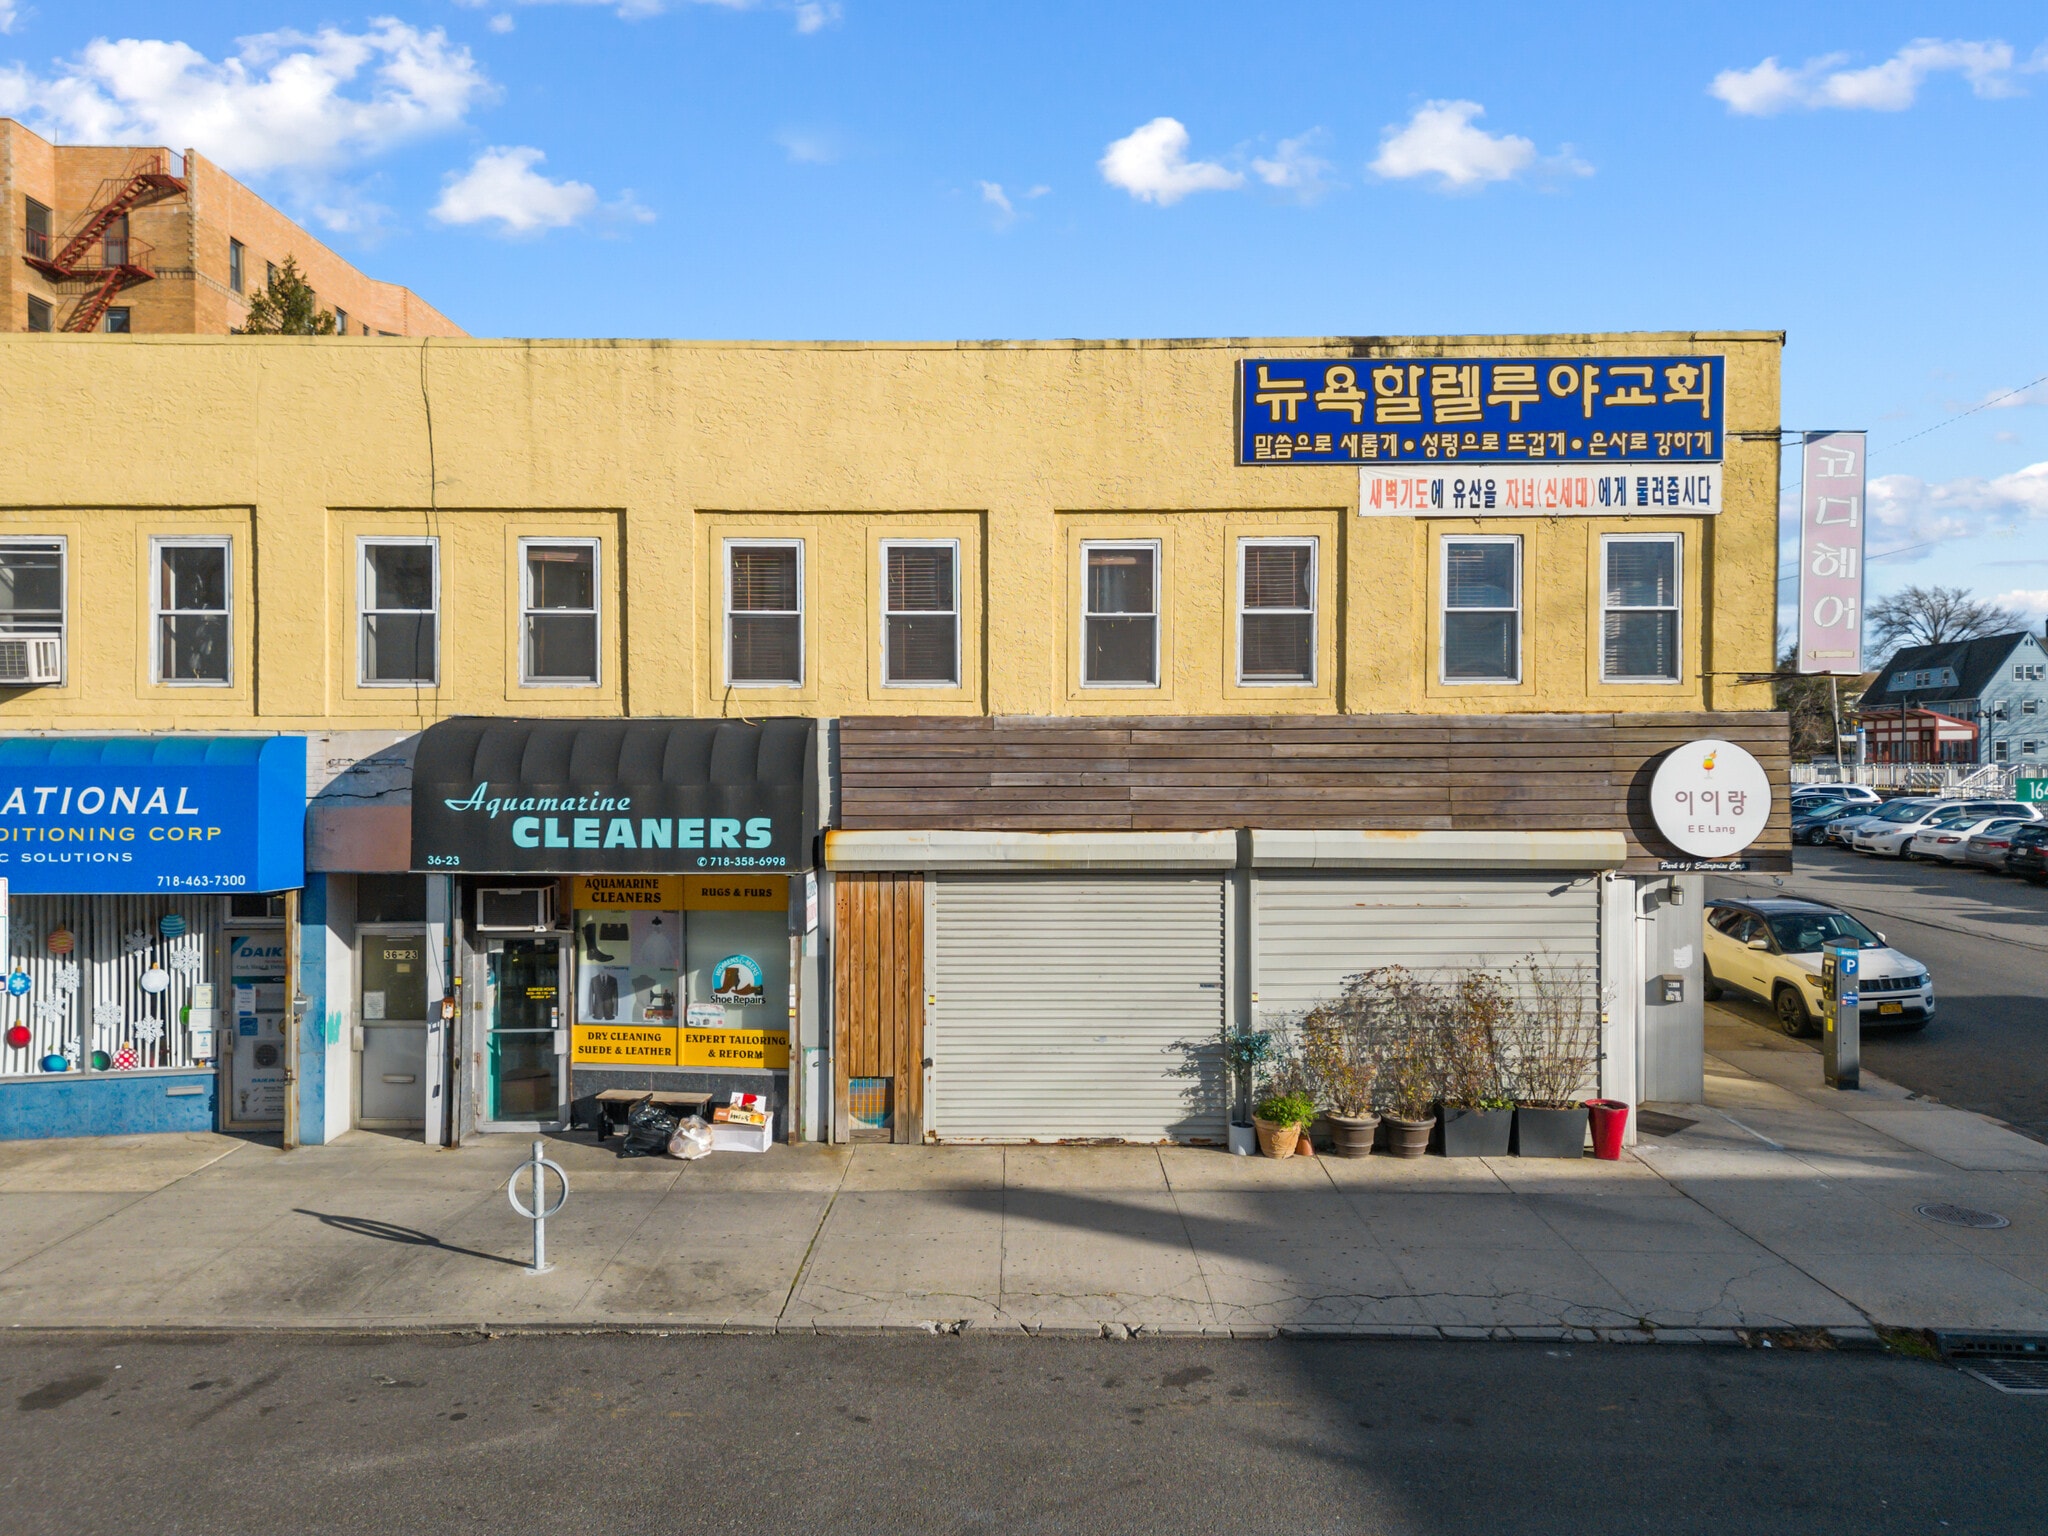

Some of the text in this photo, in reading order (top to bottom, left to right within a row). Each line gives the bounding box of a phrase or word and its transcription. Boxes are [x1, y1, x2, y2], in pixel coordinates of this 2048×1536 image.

[1255, 363, 1711, 424] 뉴욕할렐루야교회
[1255, 431, 1713, 460] 말씀으로 새롭게 성령으로 뜨겁게 은사로 강하게
[1369, 474, 1712, 510] 새벽기도에 유산을 자녀(신세대)에게 물려줍시다
[0, 786, 199, 815] ATIONAL
[444, 781, 631, 819] Aquamarine
[149, 827, 222, 841] CORP
[511, 816, 773, 849] CLEANERS
[21, 852, 133, 863] SOLUTIONS
[427, 855, 460, 866] 36-23
[710, 856, 786, 867] 718-358-6998
[157, 875, 246, 887] 718-463-7300
[585, 878, 659, 890] AQUAMARINE
[591, 892, 661, 904] CLEANERS
[701, 888, 773, 898] RUGS & FURS
[240, 947, 285, 957] DAIK
[385, 950, 418, 959] 36-23
[1846, 959, 1856, 972] P
[710, 994, 767, 1007] Shoe Repairs
[587, 1032, 662, 1042] DRY CLEANING
[685, 1034, 787, 1047] EXPERT TAILORING
[578, 1045, 672, 1057] SUEDE & LEATHER
[707, 1049, 764, 1060] & REFORM
